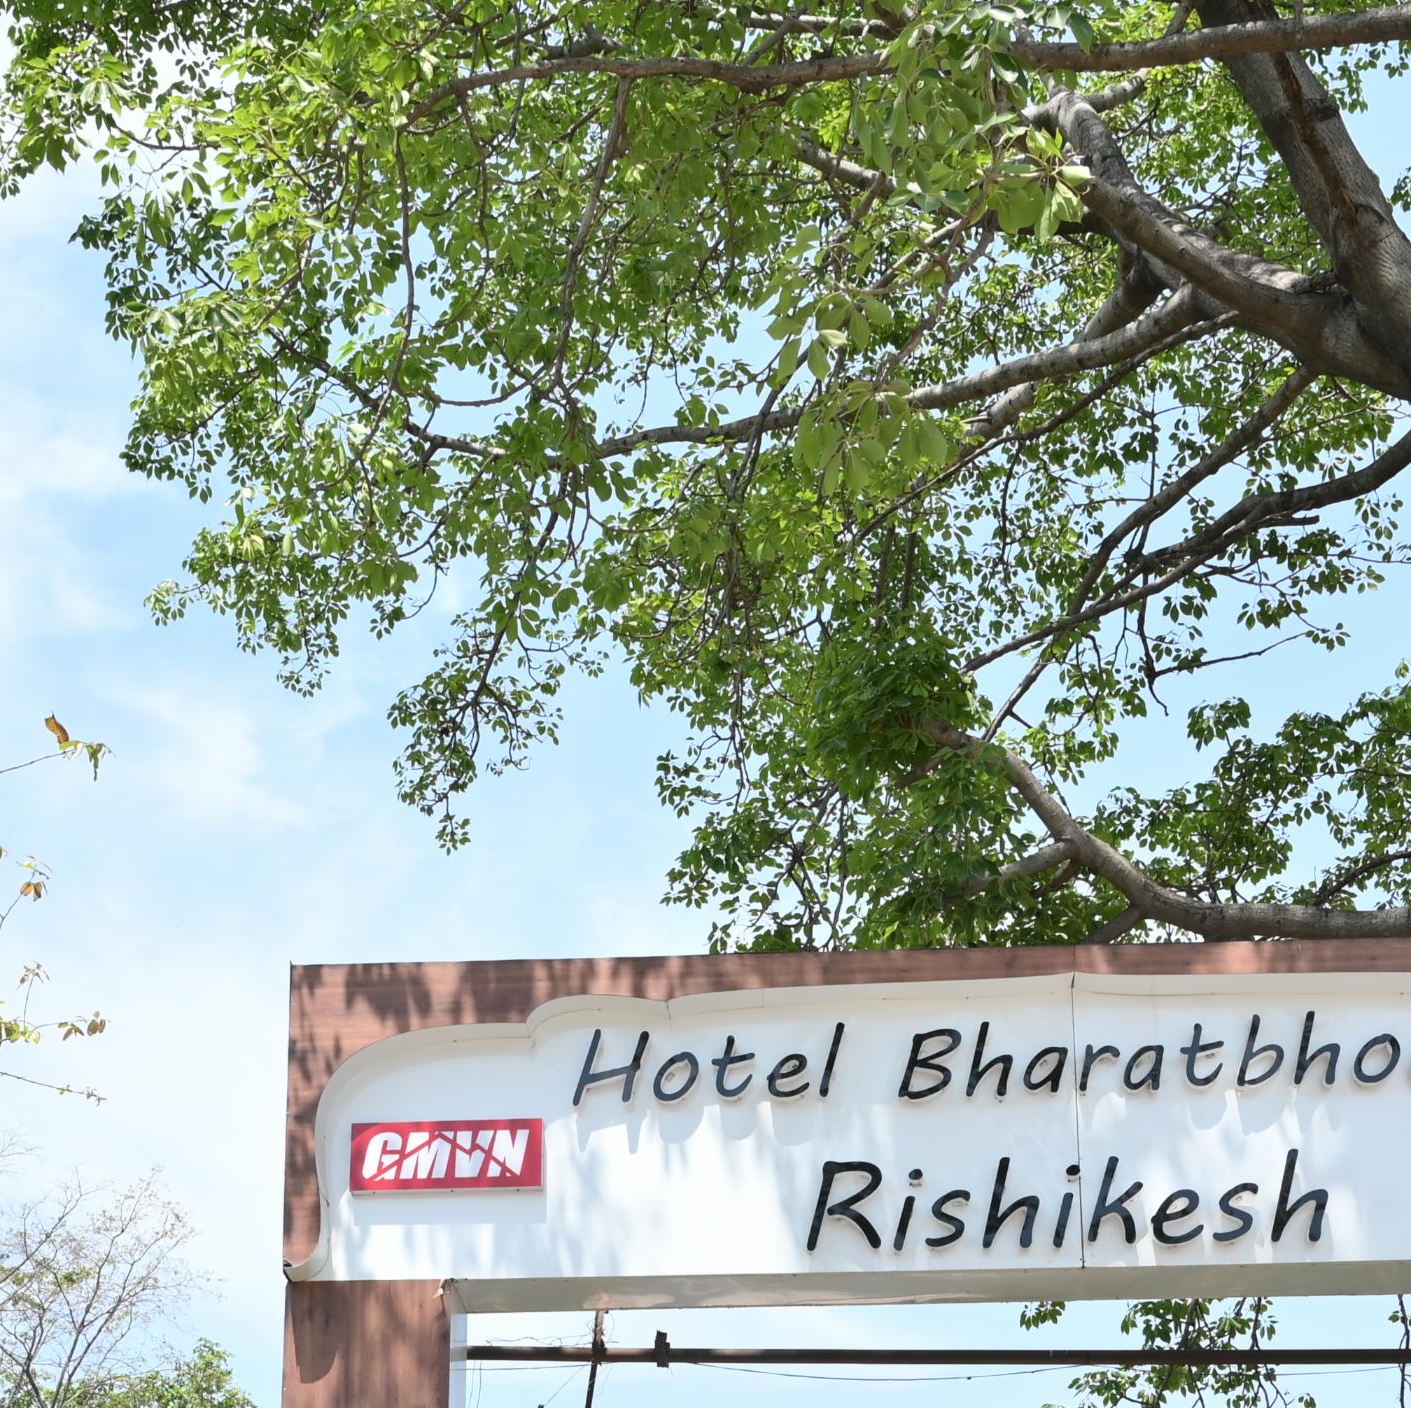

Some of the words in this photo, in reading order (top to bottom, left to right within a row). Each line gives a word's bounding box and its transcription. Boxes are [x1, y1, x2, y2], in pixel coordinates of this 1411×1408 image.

[572, 1021, 846, 1107] Hotel
[361, 1129, 530, 1181] GMVN
[806, 1148, 1330, 1252] Rishikesh
